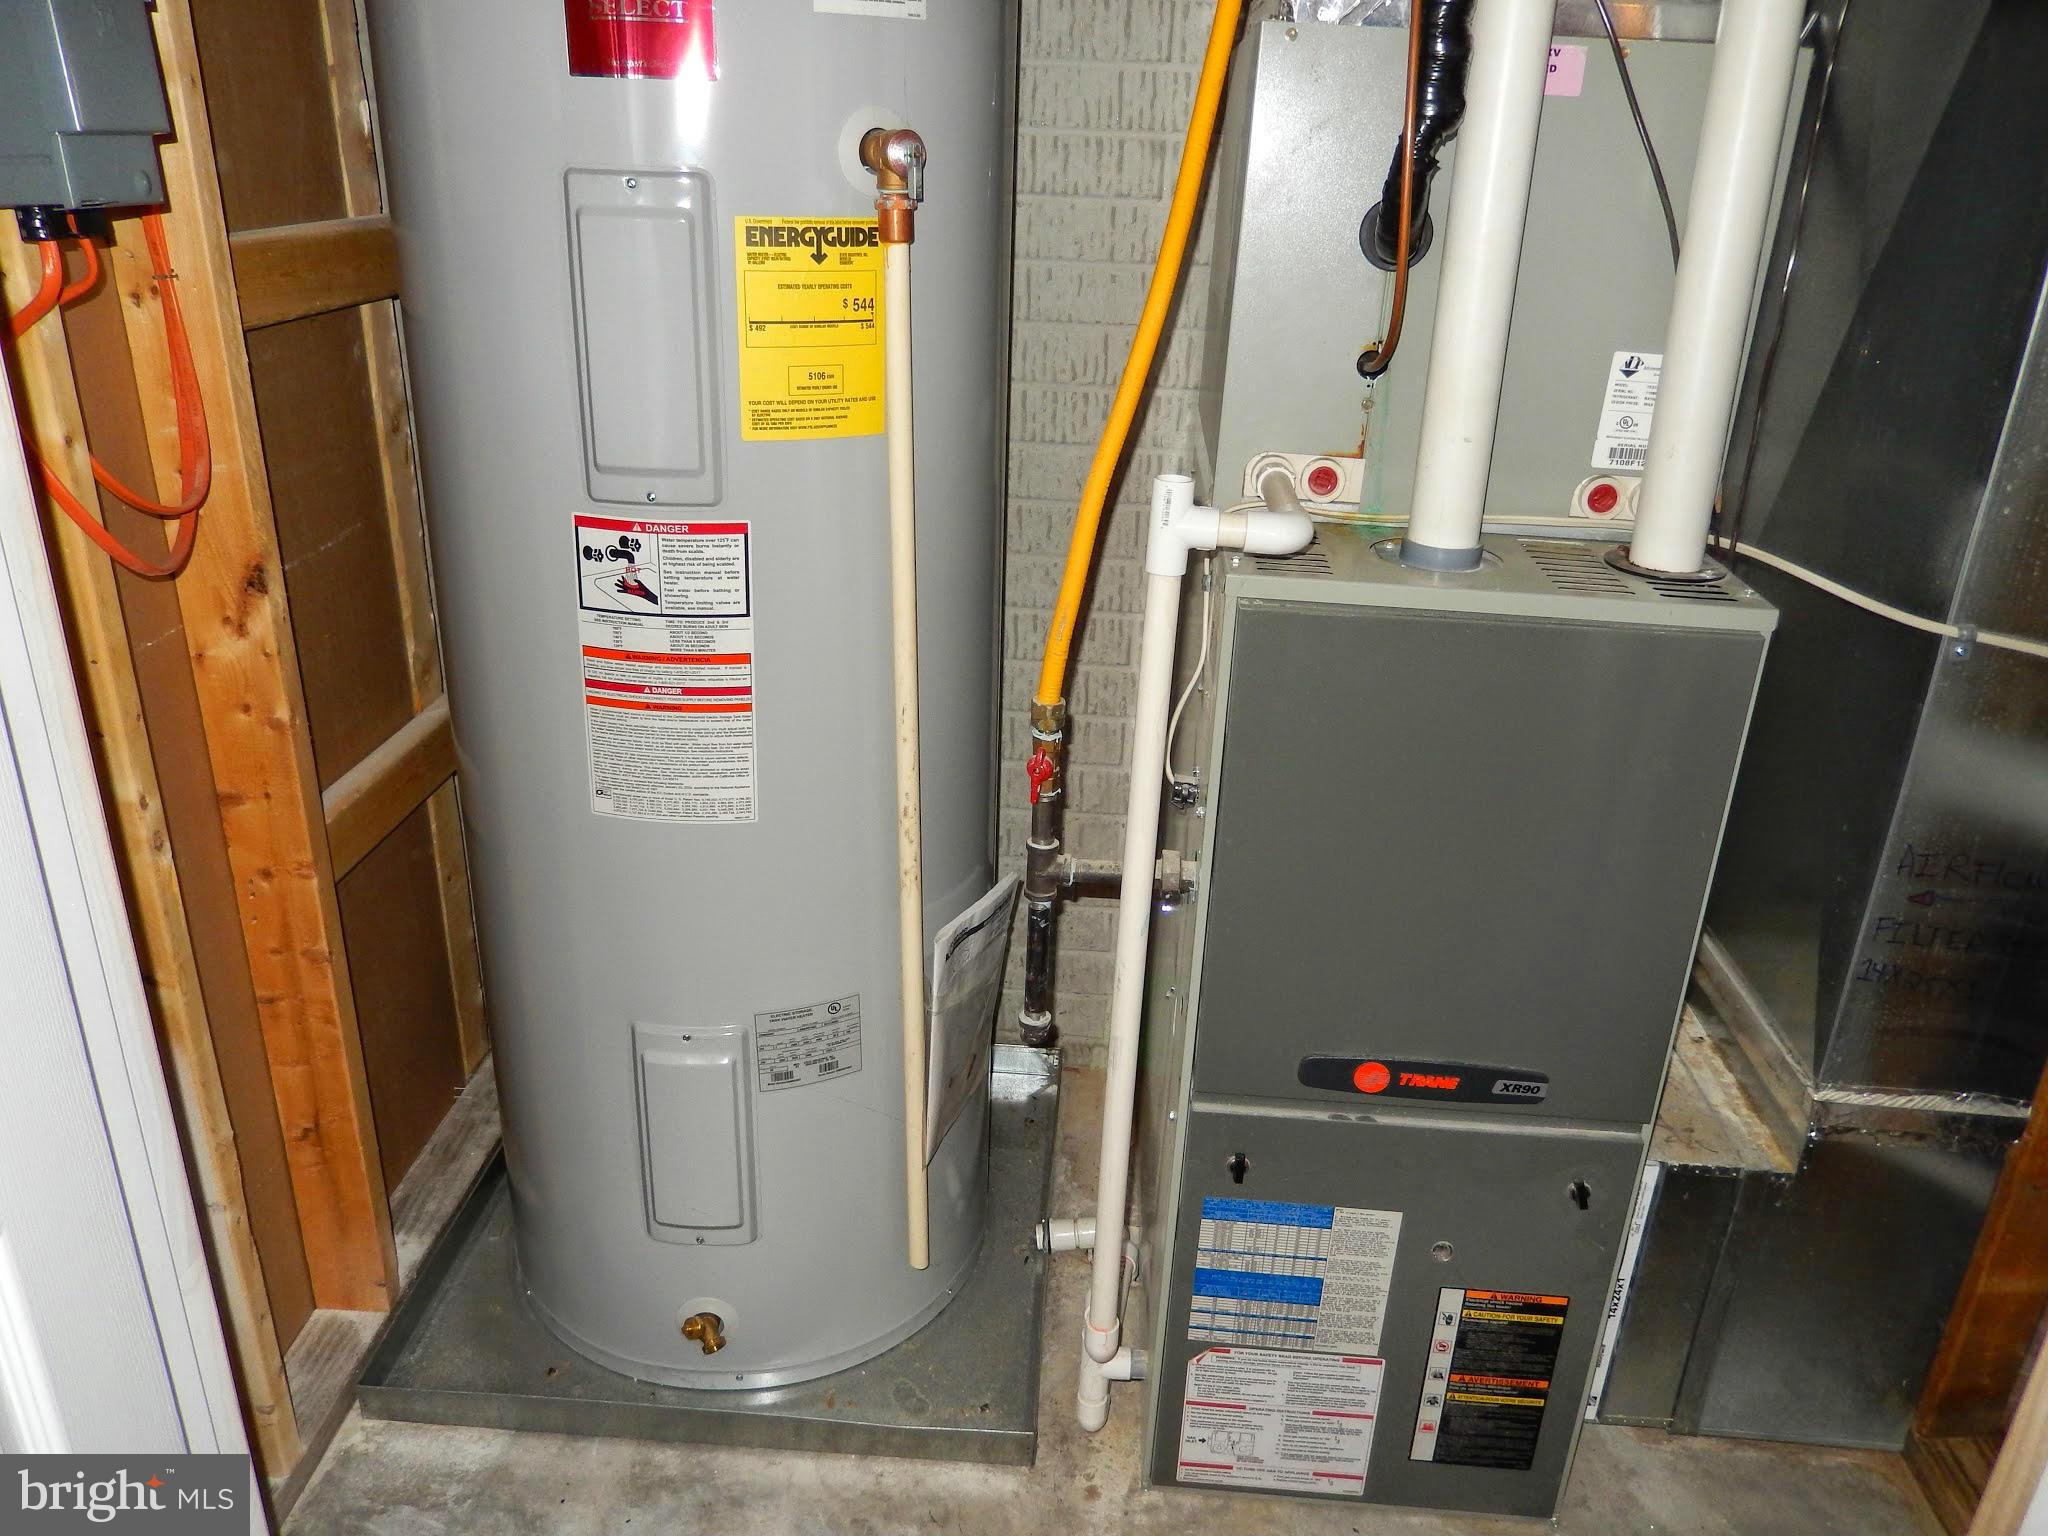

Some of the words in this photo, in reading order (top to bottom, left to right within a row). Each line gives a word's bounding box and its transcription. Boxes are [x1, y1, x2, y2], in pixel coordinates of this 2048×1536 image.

[589, 0, 687, 17] SELECT
[746, 226, 879, 248] ENERGYGUIDE
[843, 298, 848, 309] $
[853, 298, 875, 312] 544
[808, 372, 826, 380] 5106
[646, 524, 689, 533] DANGER
[1399, 1072, 1461, 1090] TRANE
[1501, 1082, 1541, 1095] XR90
[1501, 1294, 1542, 1303] WARNING
[1470, 1376, 1539, 1387] AVERTISSEMENT
